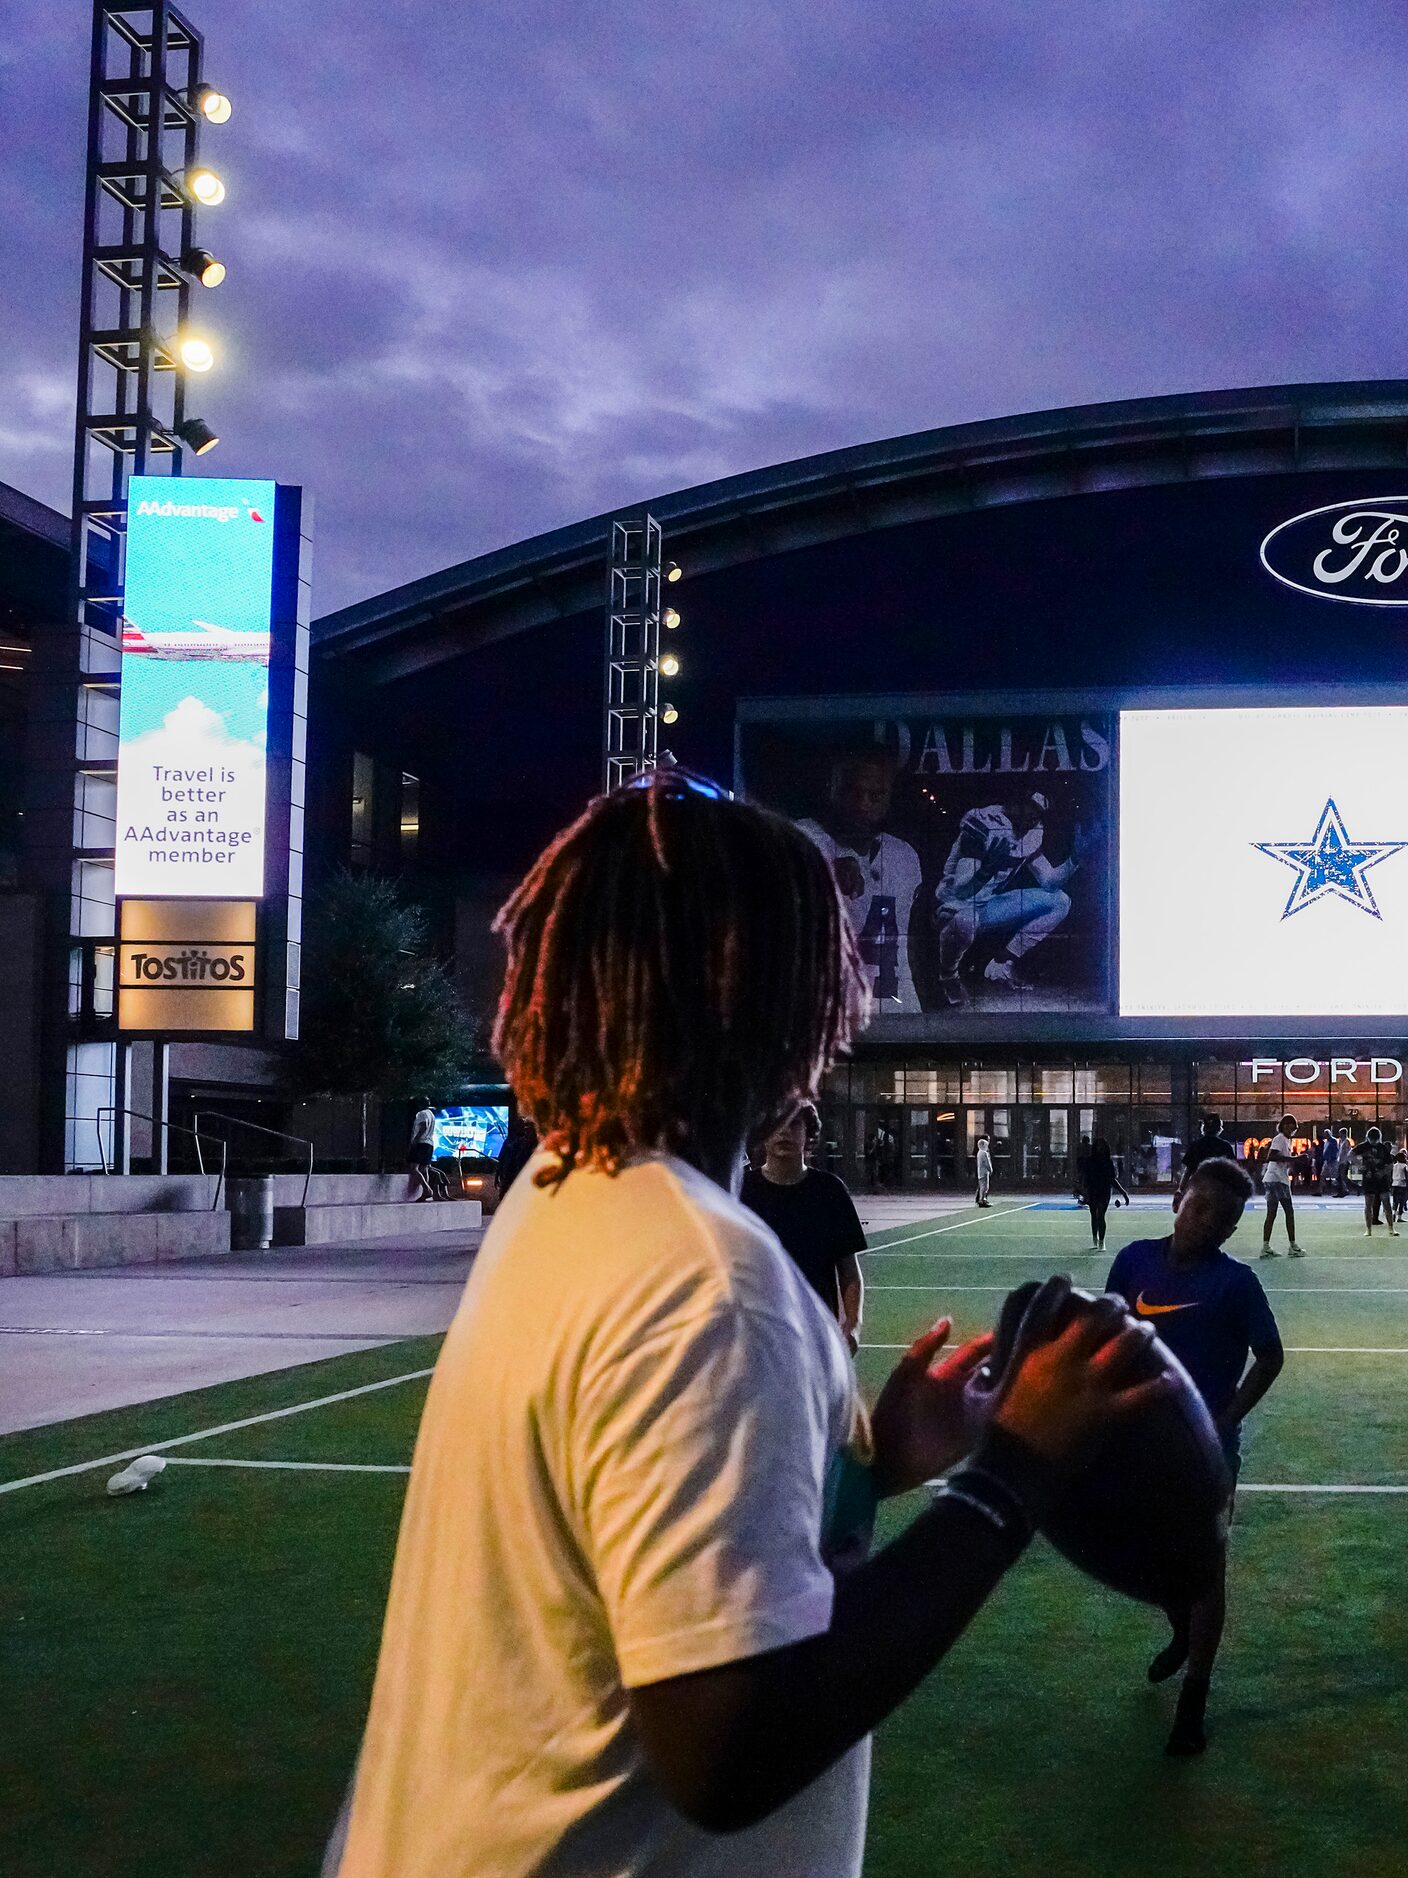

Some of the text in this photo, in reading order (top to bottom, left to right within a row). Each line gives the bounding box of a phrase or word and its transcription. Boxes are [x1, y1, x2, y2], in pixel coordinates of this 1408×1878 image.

[136, 500, 240, 523] AAdvantage
[153, 765, 236, 783] Travel is
[161, 786, 227, 803] better
[166, 809, 219, 823] as an
[124, 826, 252, 847] AAdvantage
[148, 848, 236, 864] member
[1251, 1057, 1403, 1084] FORD
